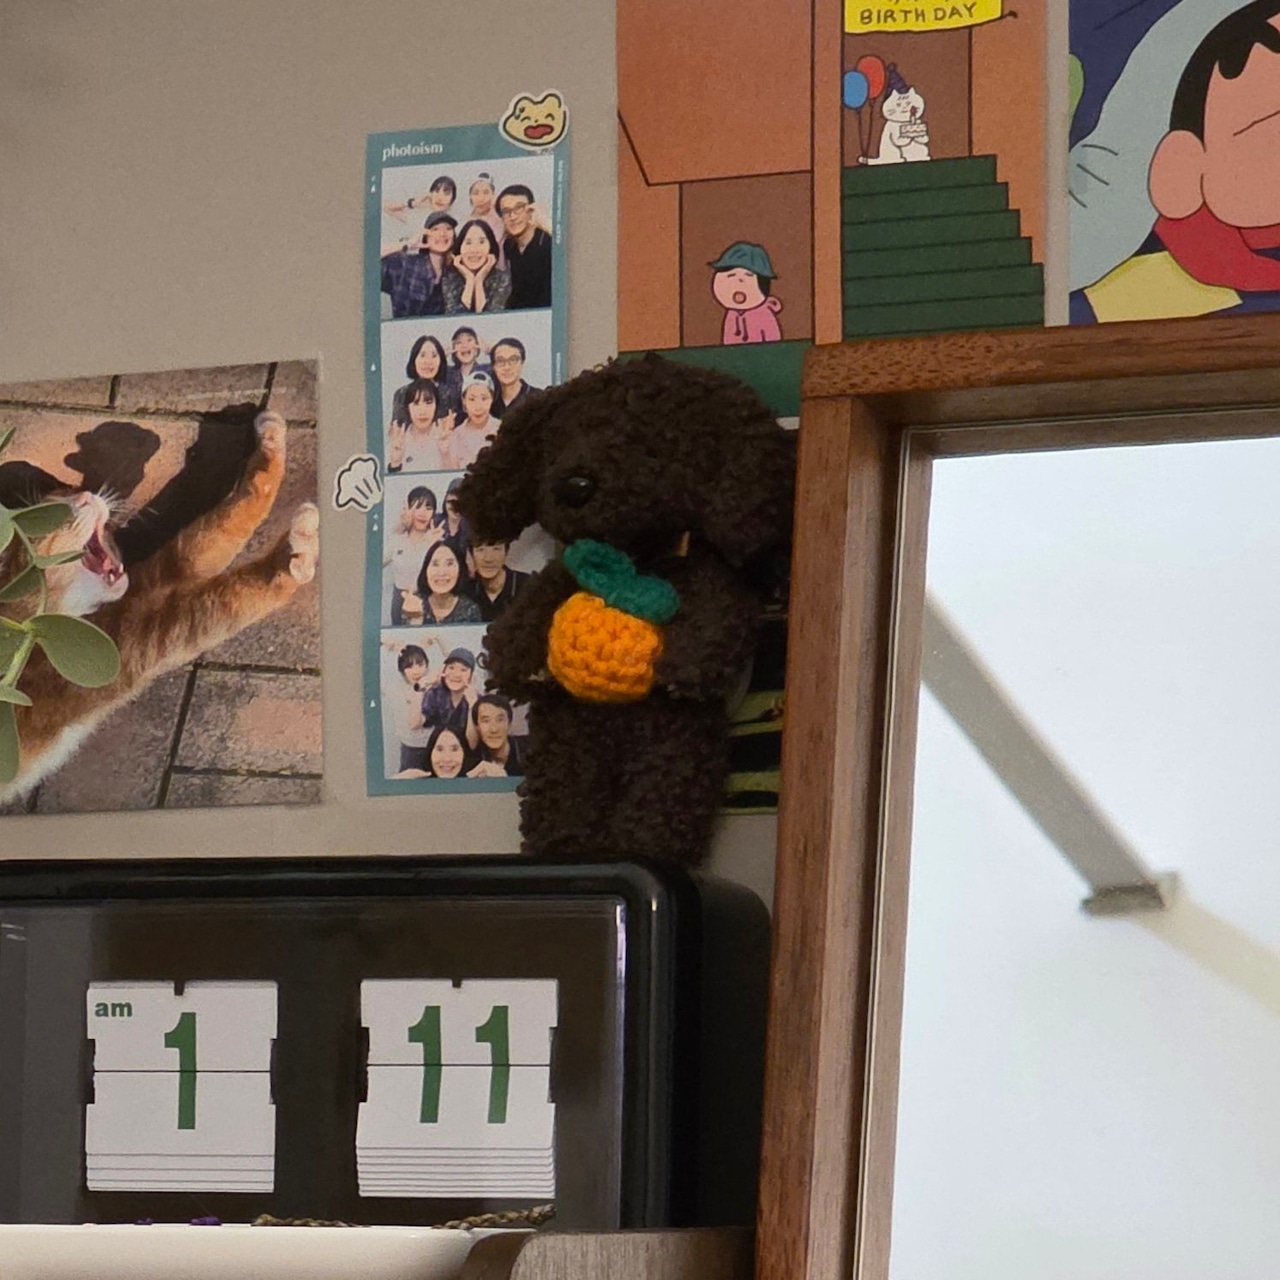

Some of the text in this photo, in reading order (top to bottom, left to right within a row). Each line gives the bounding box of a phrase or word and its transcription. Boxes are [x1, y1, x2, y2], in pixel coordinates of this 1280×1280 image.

[381, 141, 444, 162] photoism
[94, 1000, 133, 1018] am
[163, 1004, 510, 1131] 1 11
